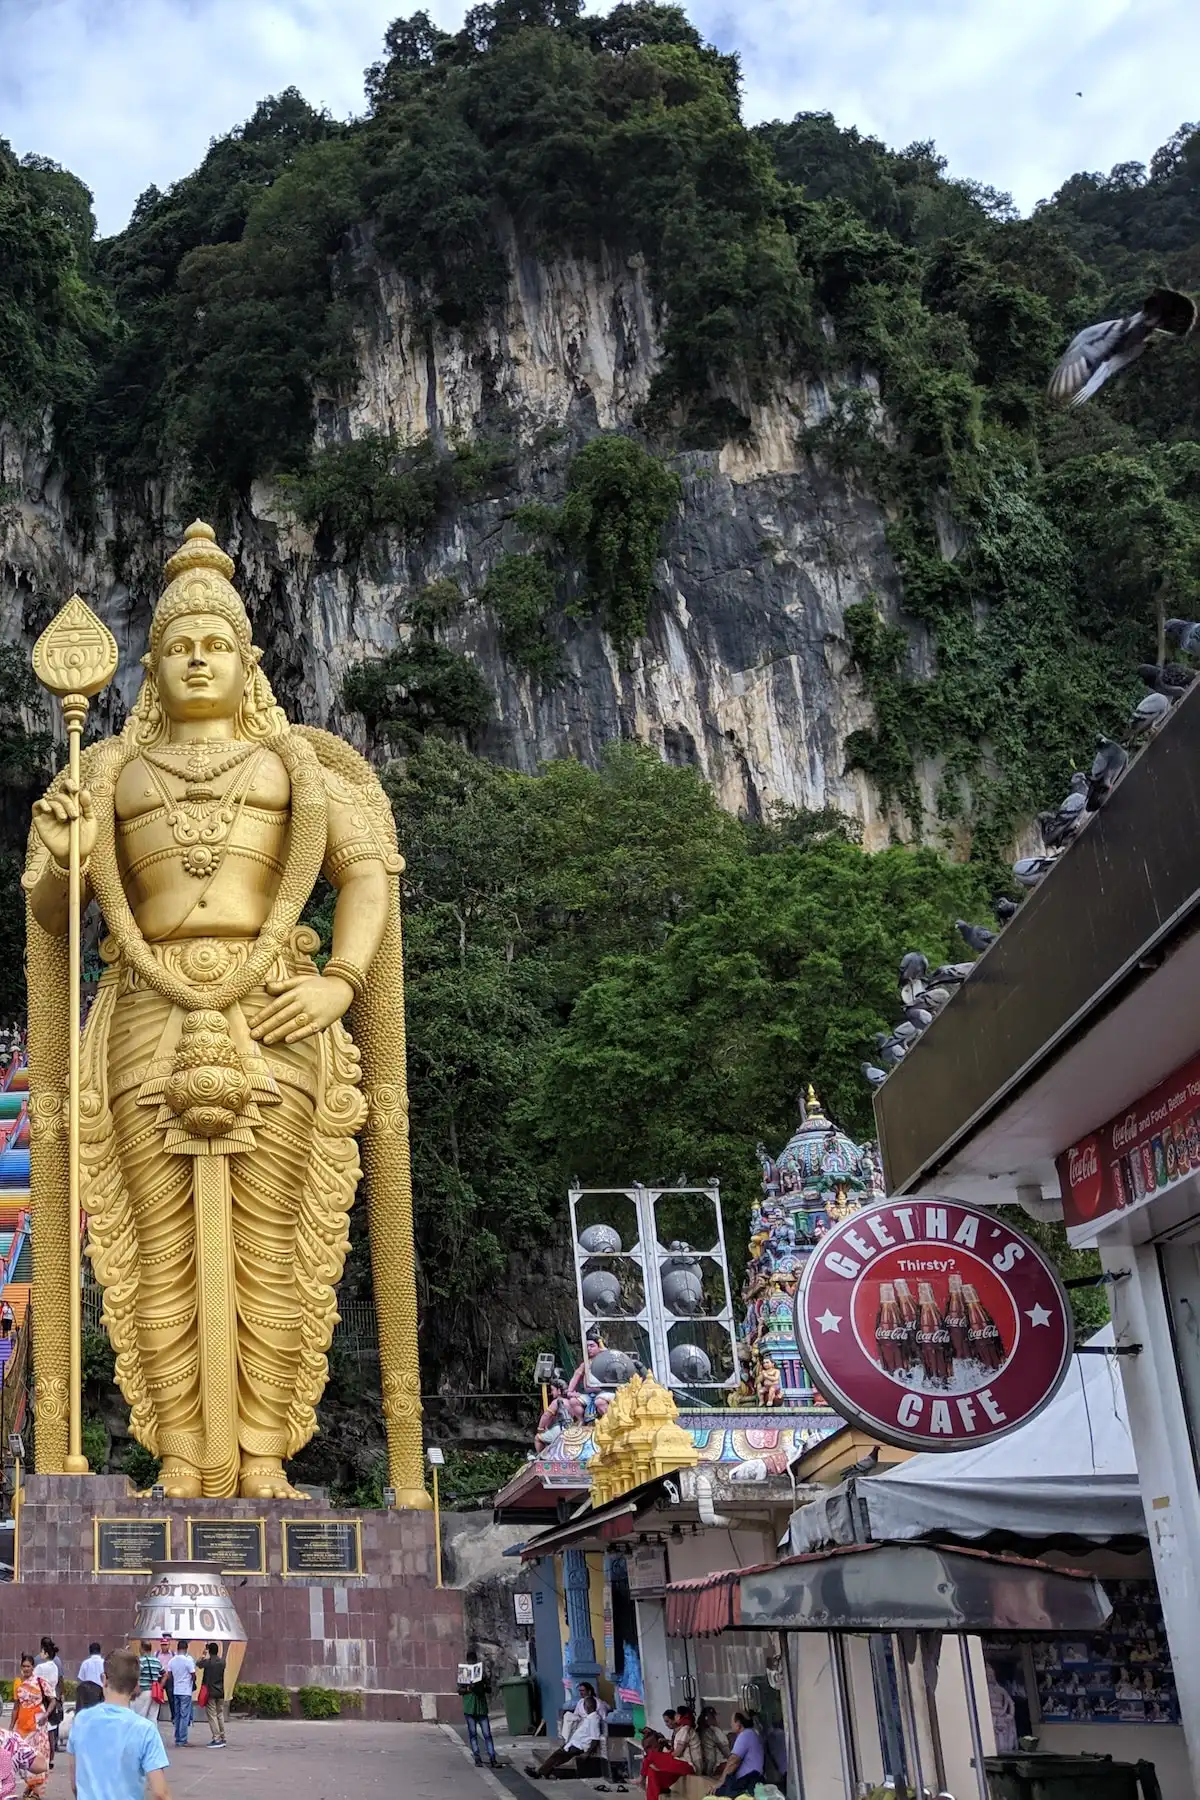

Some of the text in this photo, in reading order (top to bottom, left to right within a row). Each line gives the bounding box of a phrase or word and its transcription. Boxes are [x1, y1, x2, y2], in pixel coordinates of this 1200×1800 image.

[824, 1207, 1025, 1280] GEETHA'S
[897, 1258, 956, 1273] Thirsty?
[896, 1389, 1007, 1435] CAFE
[133, 1608, 232, 1632] NATION
